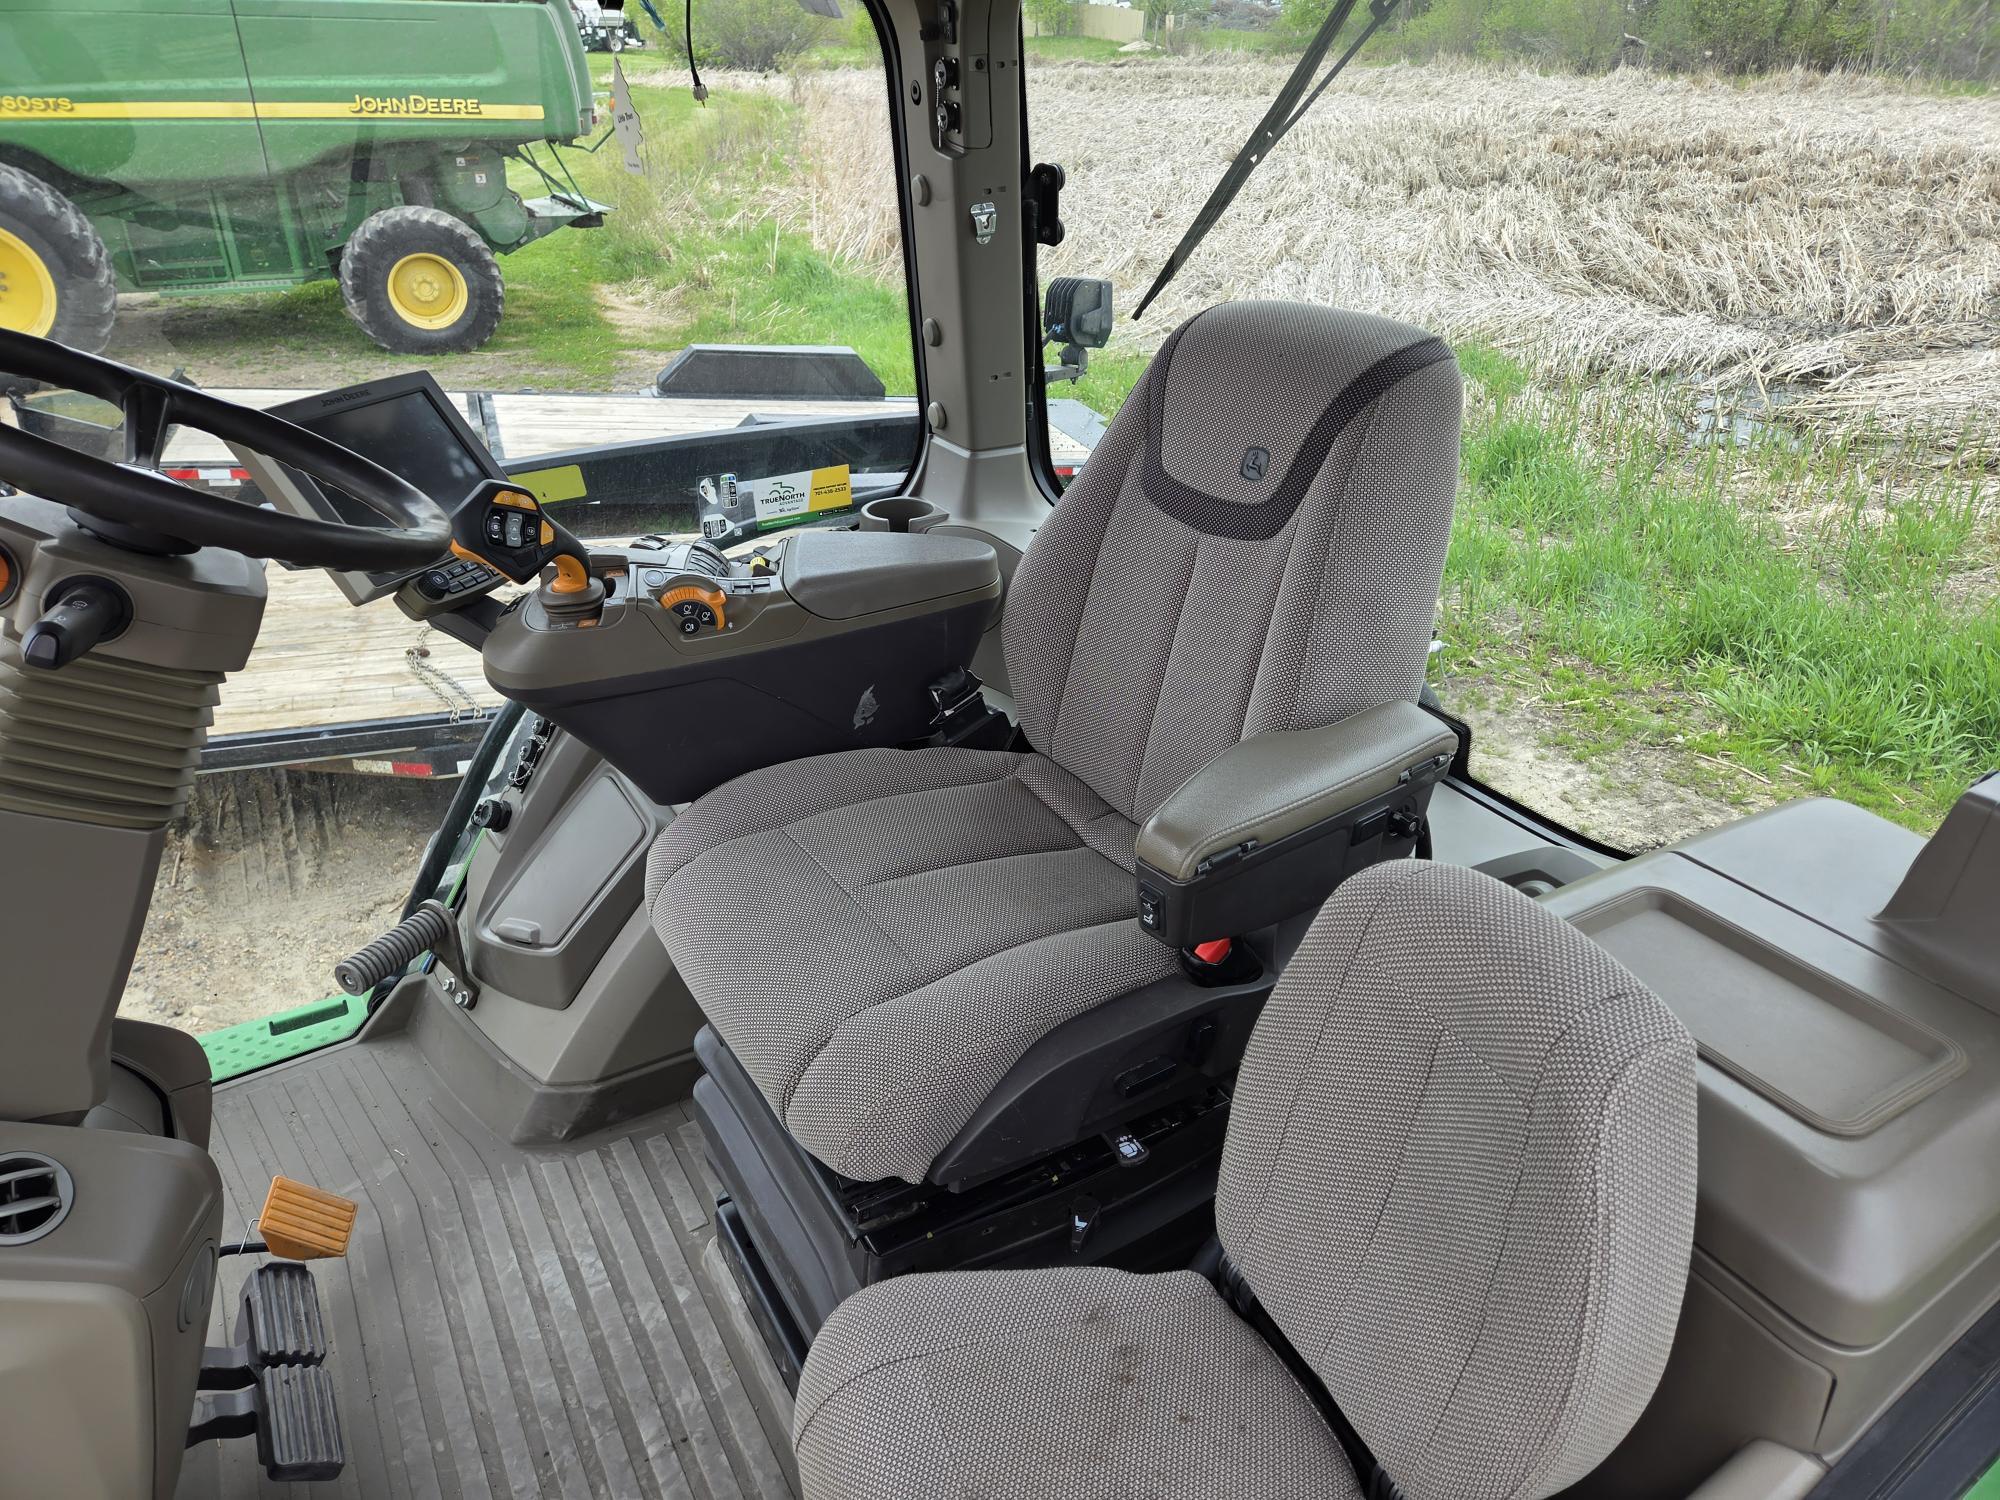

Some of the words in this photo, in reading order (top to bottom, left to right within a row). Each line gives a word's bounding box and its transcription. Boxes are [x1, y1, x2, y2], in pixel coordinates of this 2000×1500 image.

[0, 95, 73, 111] 60STS
[350, 94, 408, 113] JOHN
[408, 95, 481, 115] DEERE
